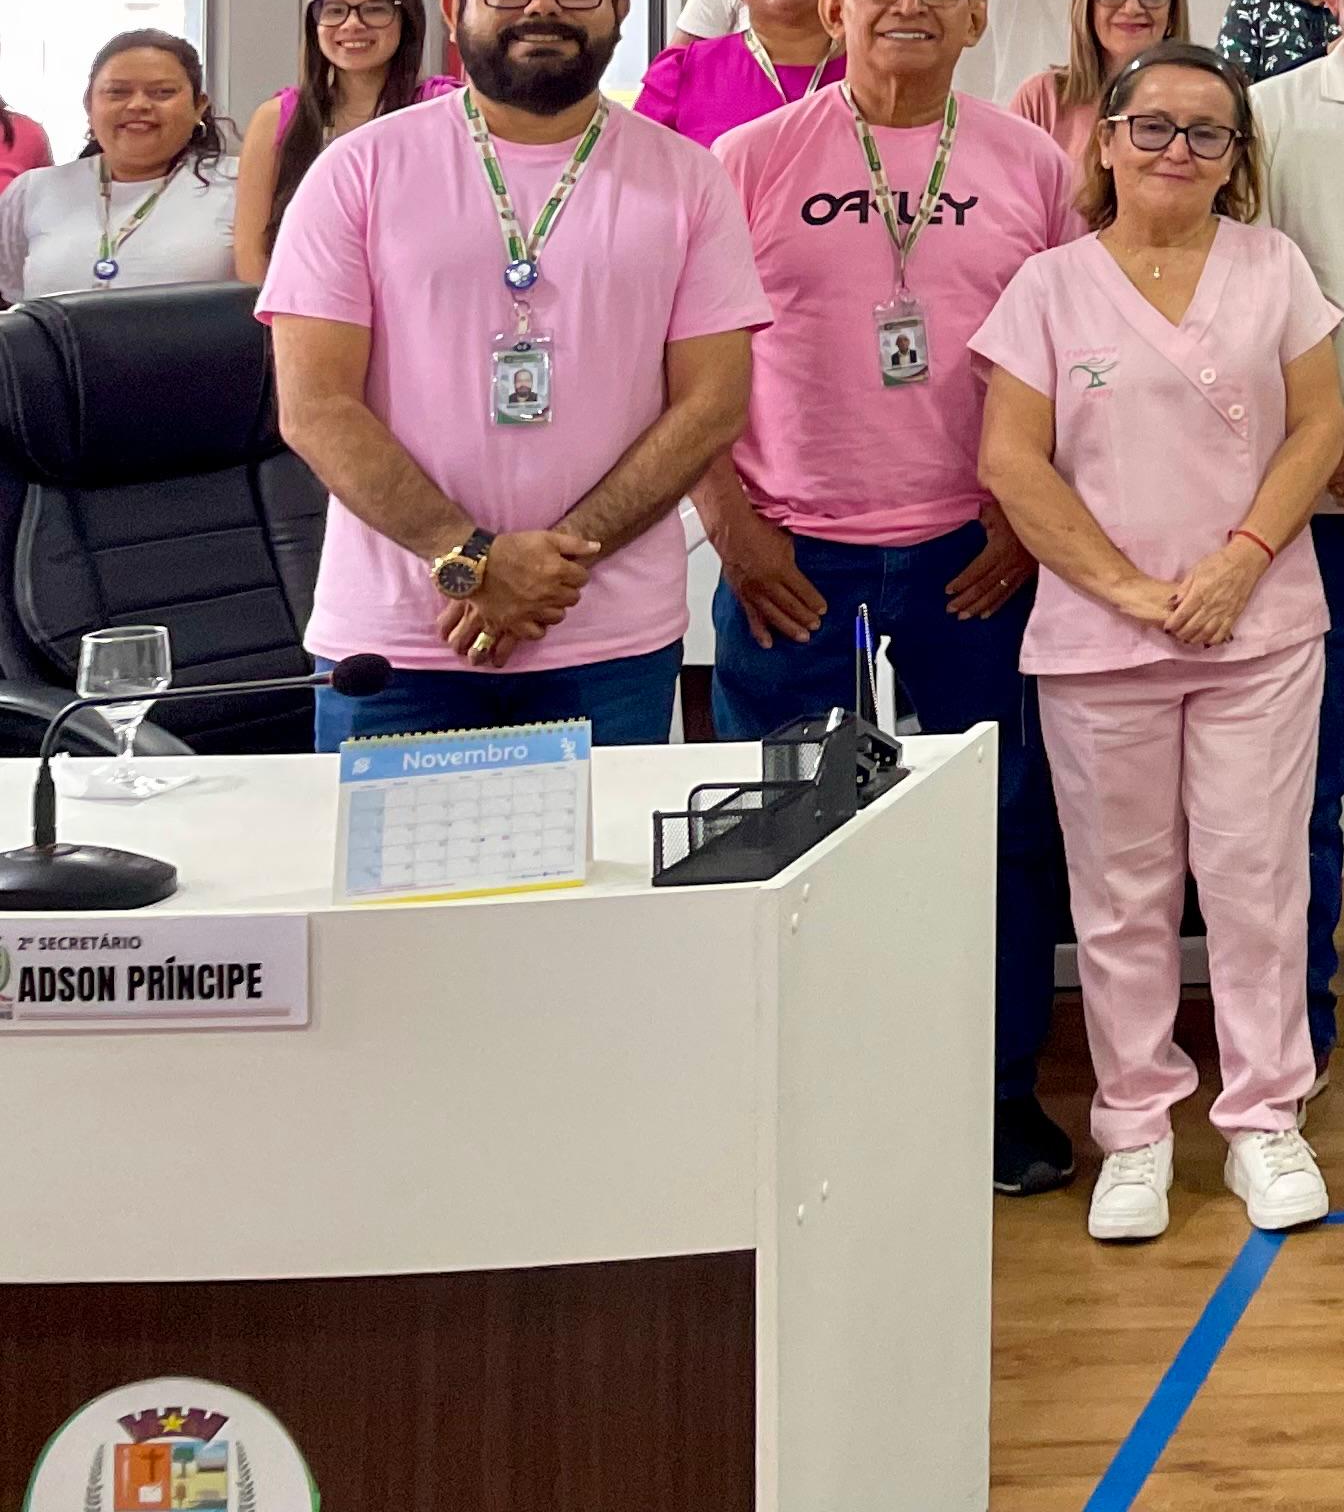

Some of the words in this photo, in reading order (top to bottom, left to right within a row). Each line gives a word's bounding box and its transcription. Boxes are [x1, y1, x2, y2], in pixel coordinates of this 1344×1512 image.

[402, 743, 528, 771] Novembro
[38, 933, 142, 950] SECRETÁRIO
[18, 965, 116, 1002] ADSON
[127, 955, 263, 1001] PRÍNCIPE
